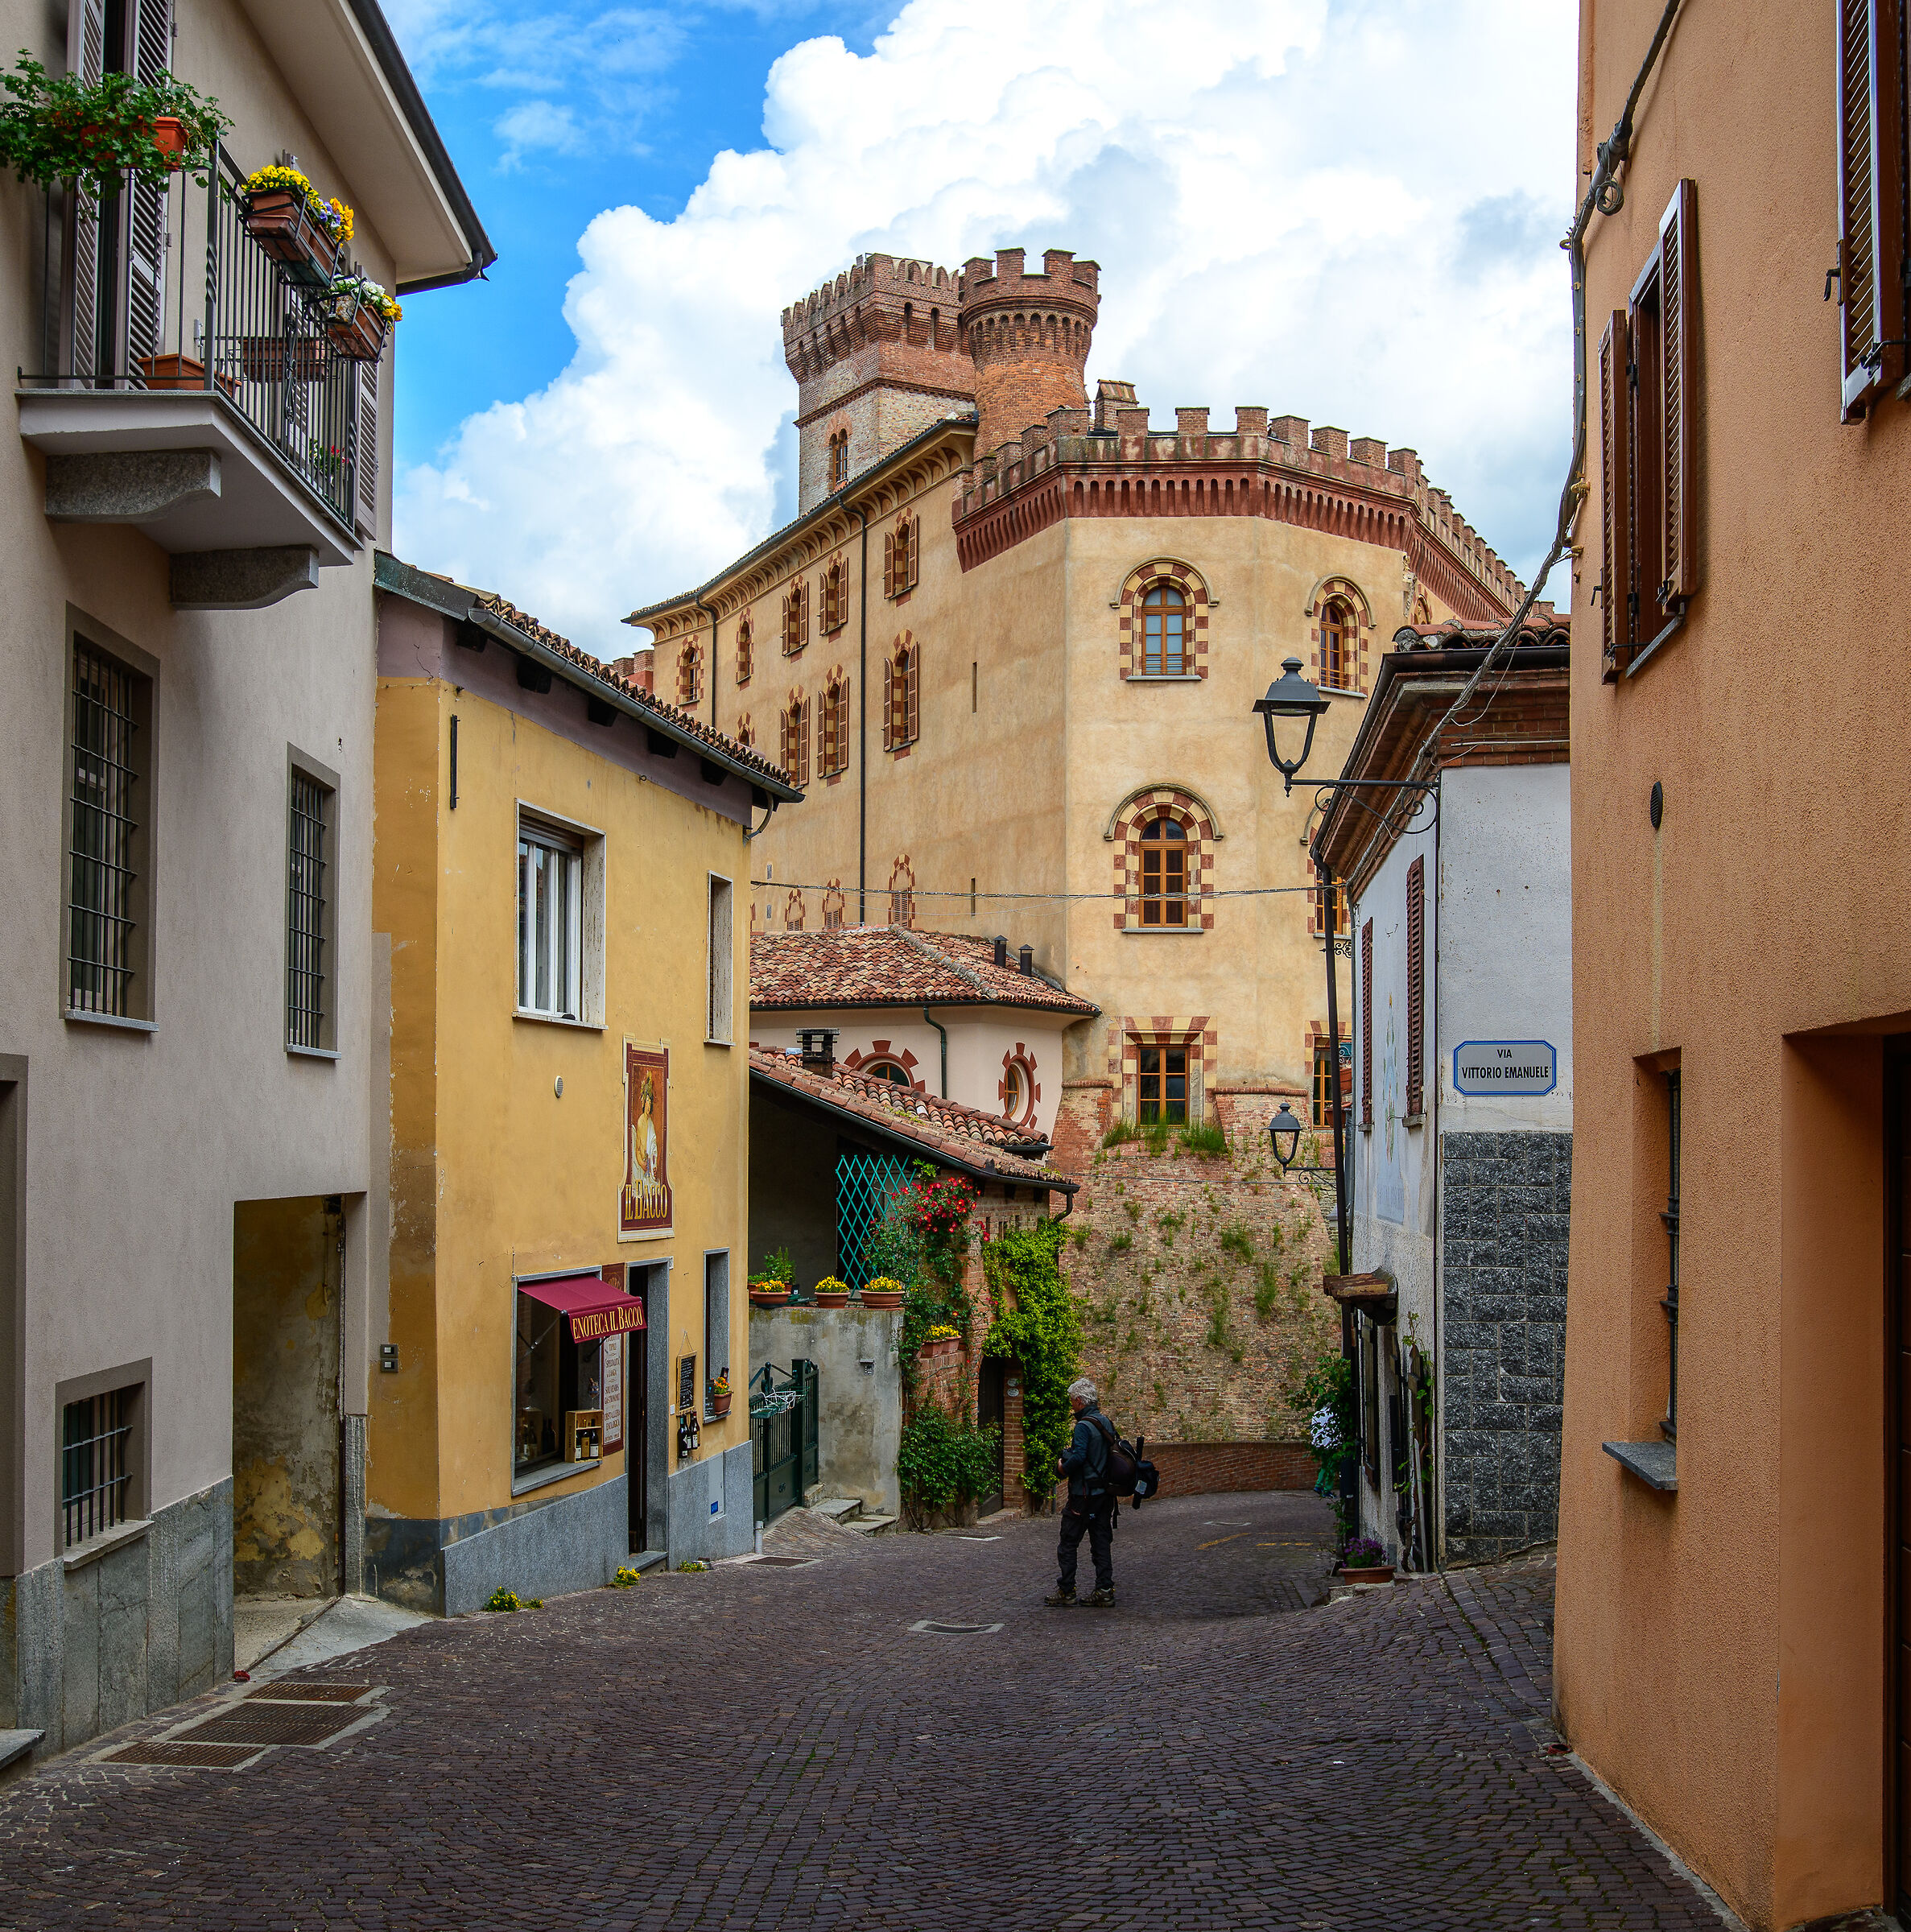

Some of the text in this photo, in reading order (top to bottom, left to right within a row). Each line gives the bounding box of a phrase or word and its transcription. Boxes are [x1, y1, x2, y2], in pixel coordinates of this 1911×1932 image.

[1496, 1049, 1513, 1059] VIA
[1461, 1066, 1549, 1079] VITTORIO EMANUELE
[625, 1179, 668, 1221] IL BACCO
[572, 1306, 643, 1340] ENOTECA IL BACCO
